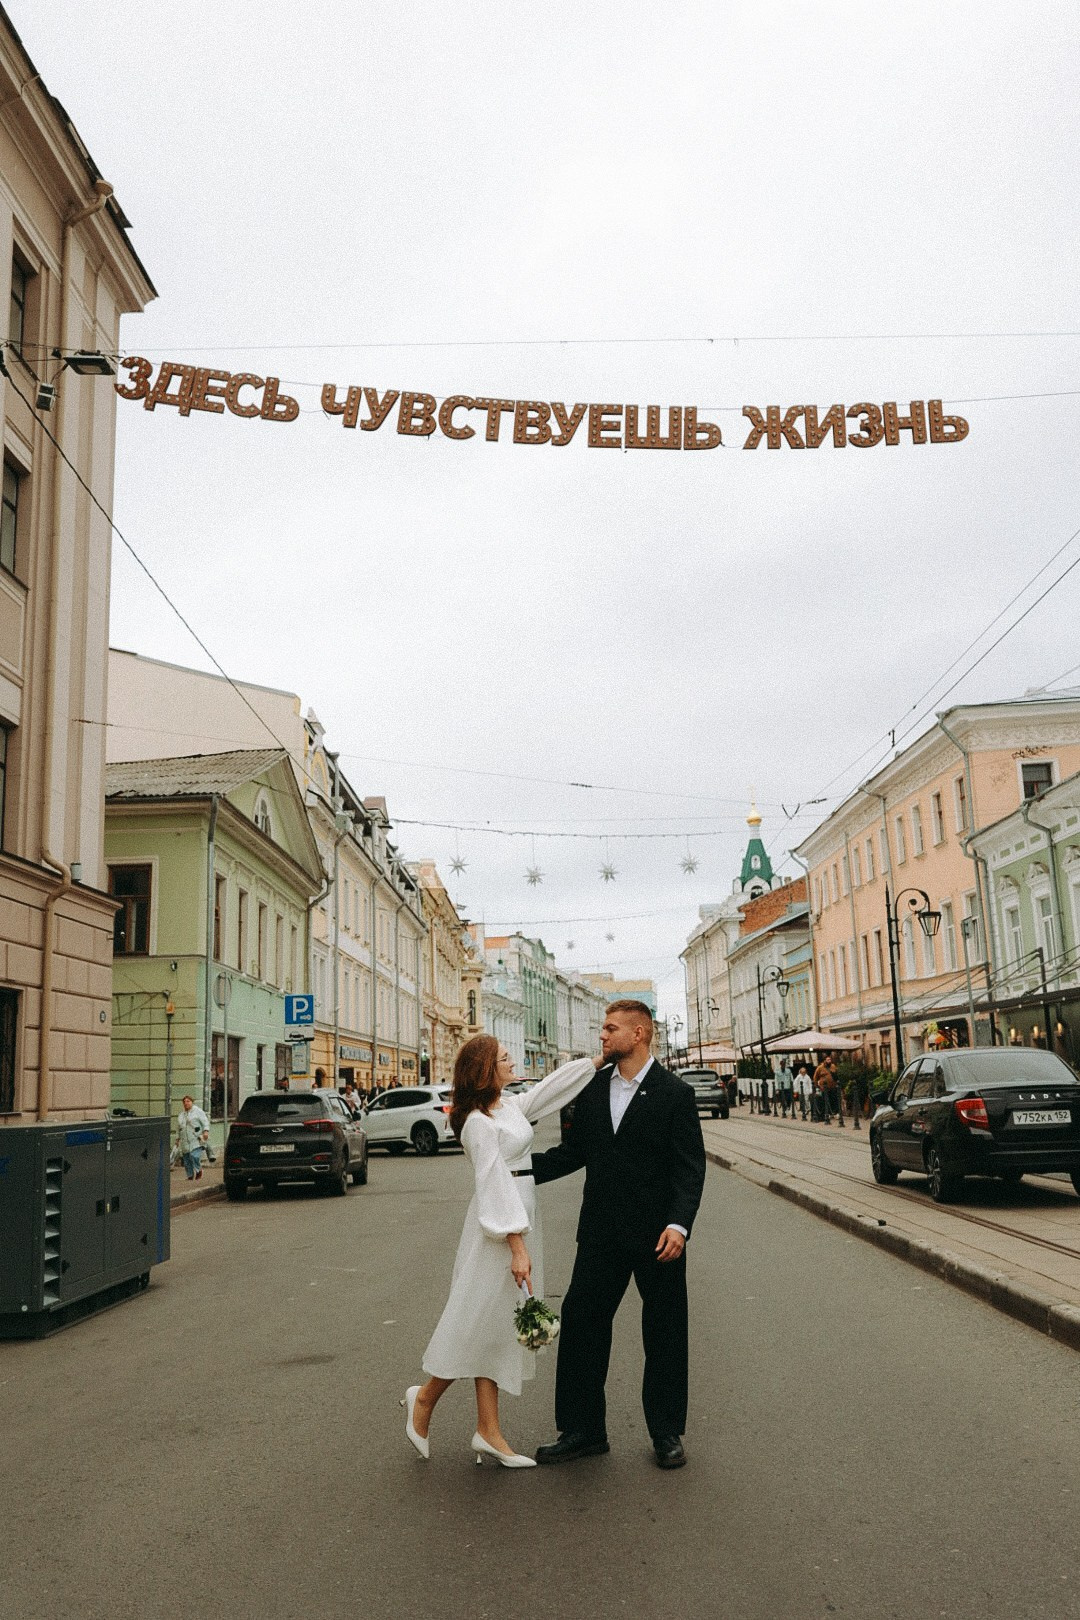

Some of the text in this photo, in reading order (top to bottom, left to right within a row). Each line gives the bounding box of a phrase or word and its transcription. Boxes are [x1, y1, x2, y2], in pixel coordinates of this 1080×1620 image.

[113, 355, 970, 450] ЗДЕСЬ ЧУВСТВУЕШЬ ЖИЗНЬ
[292, 997, 309, 1022] P
[1018, 1092, 1061, 1101] LADA
